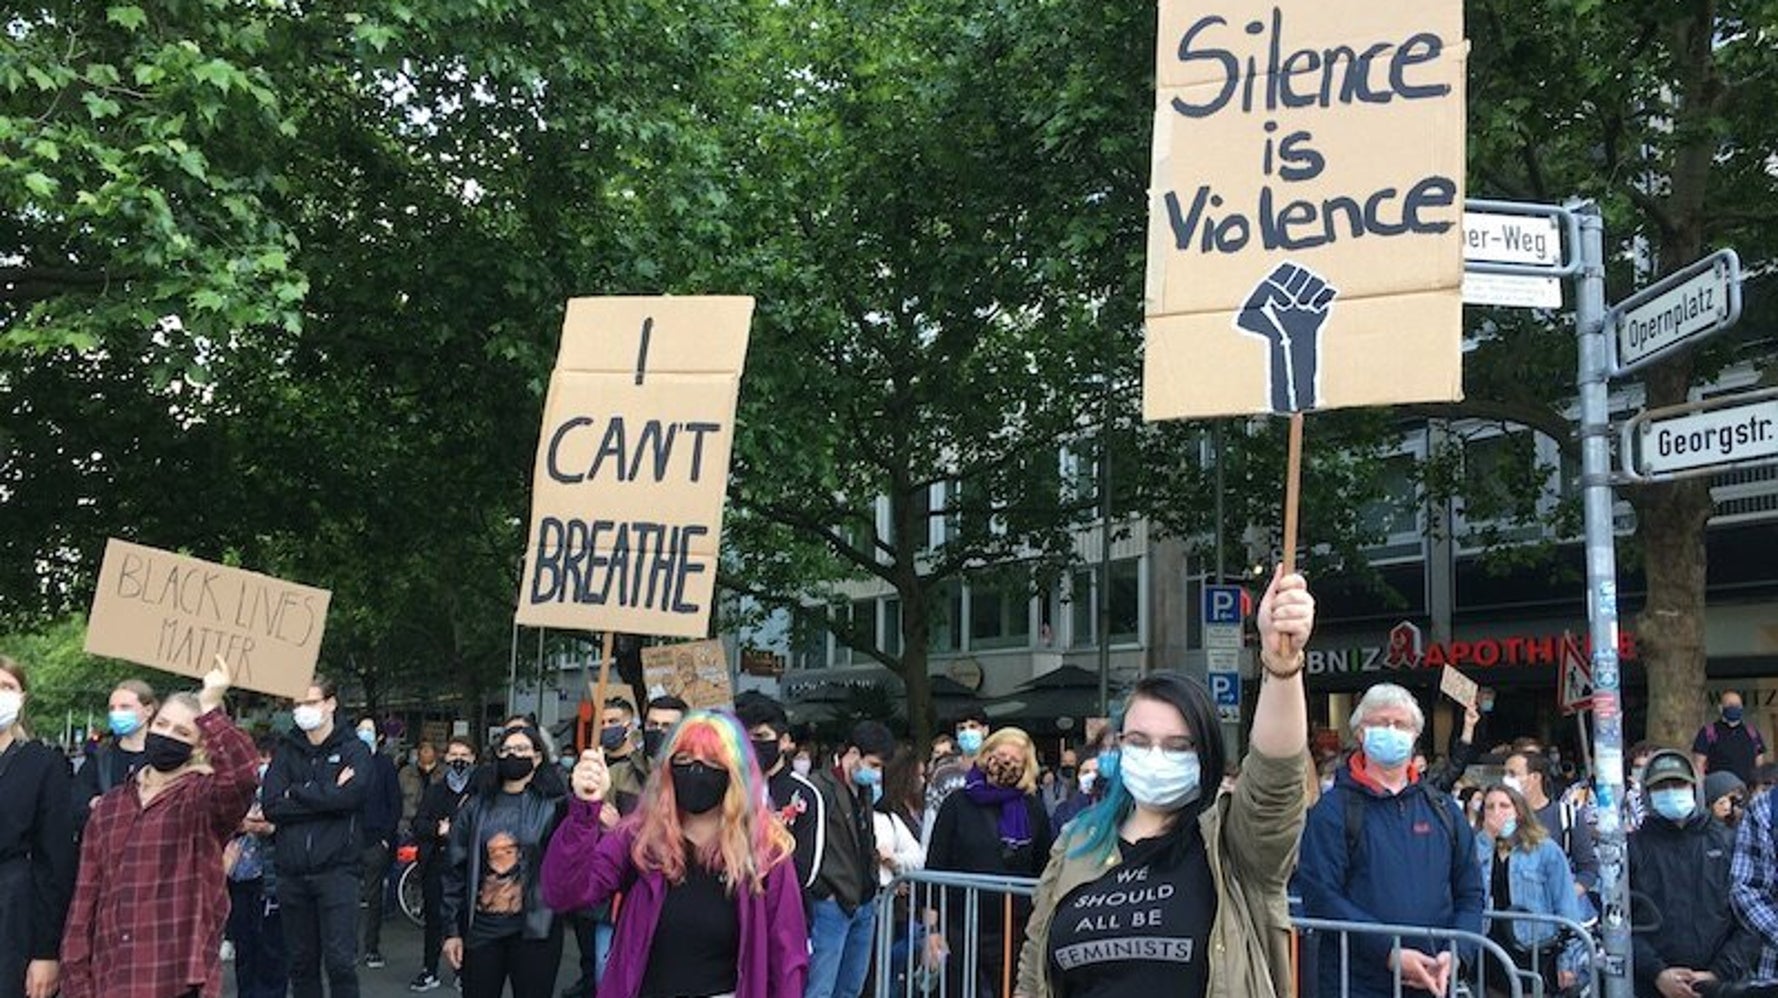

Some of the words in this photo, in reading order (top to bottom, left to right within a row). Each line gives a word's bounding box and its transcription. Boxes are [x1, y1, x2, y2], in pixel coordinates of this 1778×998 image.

[1171, 6, 1451, 118] Silence
[1263, 120, 1325, 181] is
[1164, 176, 1457, 253] Violence
[1463, 224, 1547, 260] er-Weg
[1629, 287, 1716, 348] Opernplatz
[635, 316, 653, 386] I
[547, 416, 721, 484] CAN'T
[1659, 414, 1774, 457] Georgstr.
[530, 516, 708, 614] BREATHE
[117, 553, 221, 621] BLACK
[235, 582, 315, 648] LIVES
[156, 618, 255, 683] MATTER
[1307, 647, 1381, 674] BNIZ
[1423, 630, 1637, 668] APOTHE
[1074, 884, 1175, 909] SHOULD
[1116, 865, 1149, 883] WE
[1075, 914, 1121, 932] ALL
[1131, 909, 1163, 928] BE
[1058, 940, 1189, 967] FEMINISTS
